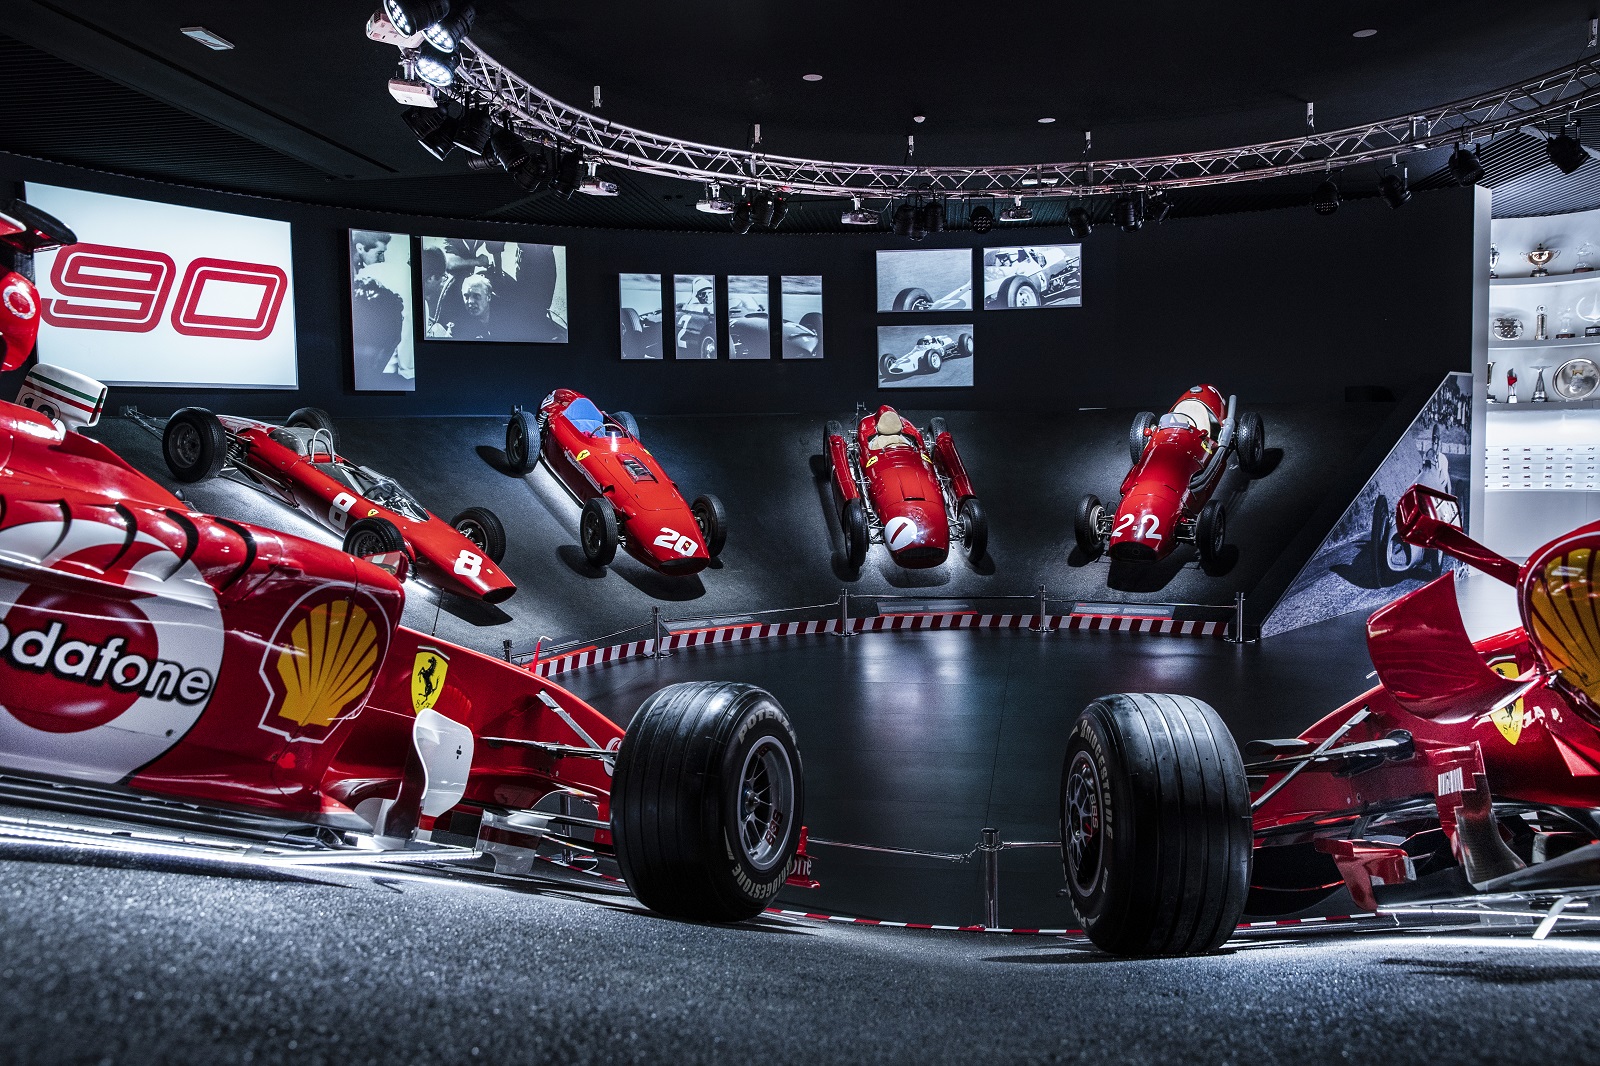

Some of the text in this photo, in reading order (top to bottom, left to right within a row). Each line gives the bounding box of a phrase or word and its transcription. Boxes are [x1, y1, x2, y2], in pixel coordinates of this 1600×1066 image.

[41, 242, 288, 340] 90
[328, 492, 357, 530] 8
[653, 527, 699, 557] 20
[453, 549, 483, 577] 8
[1079, 719, 1114, 840] BRIDGESTONE
[1089, 793, 1099, 829] BBS
